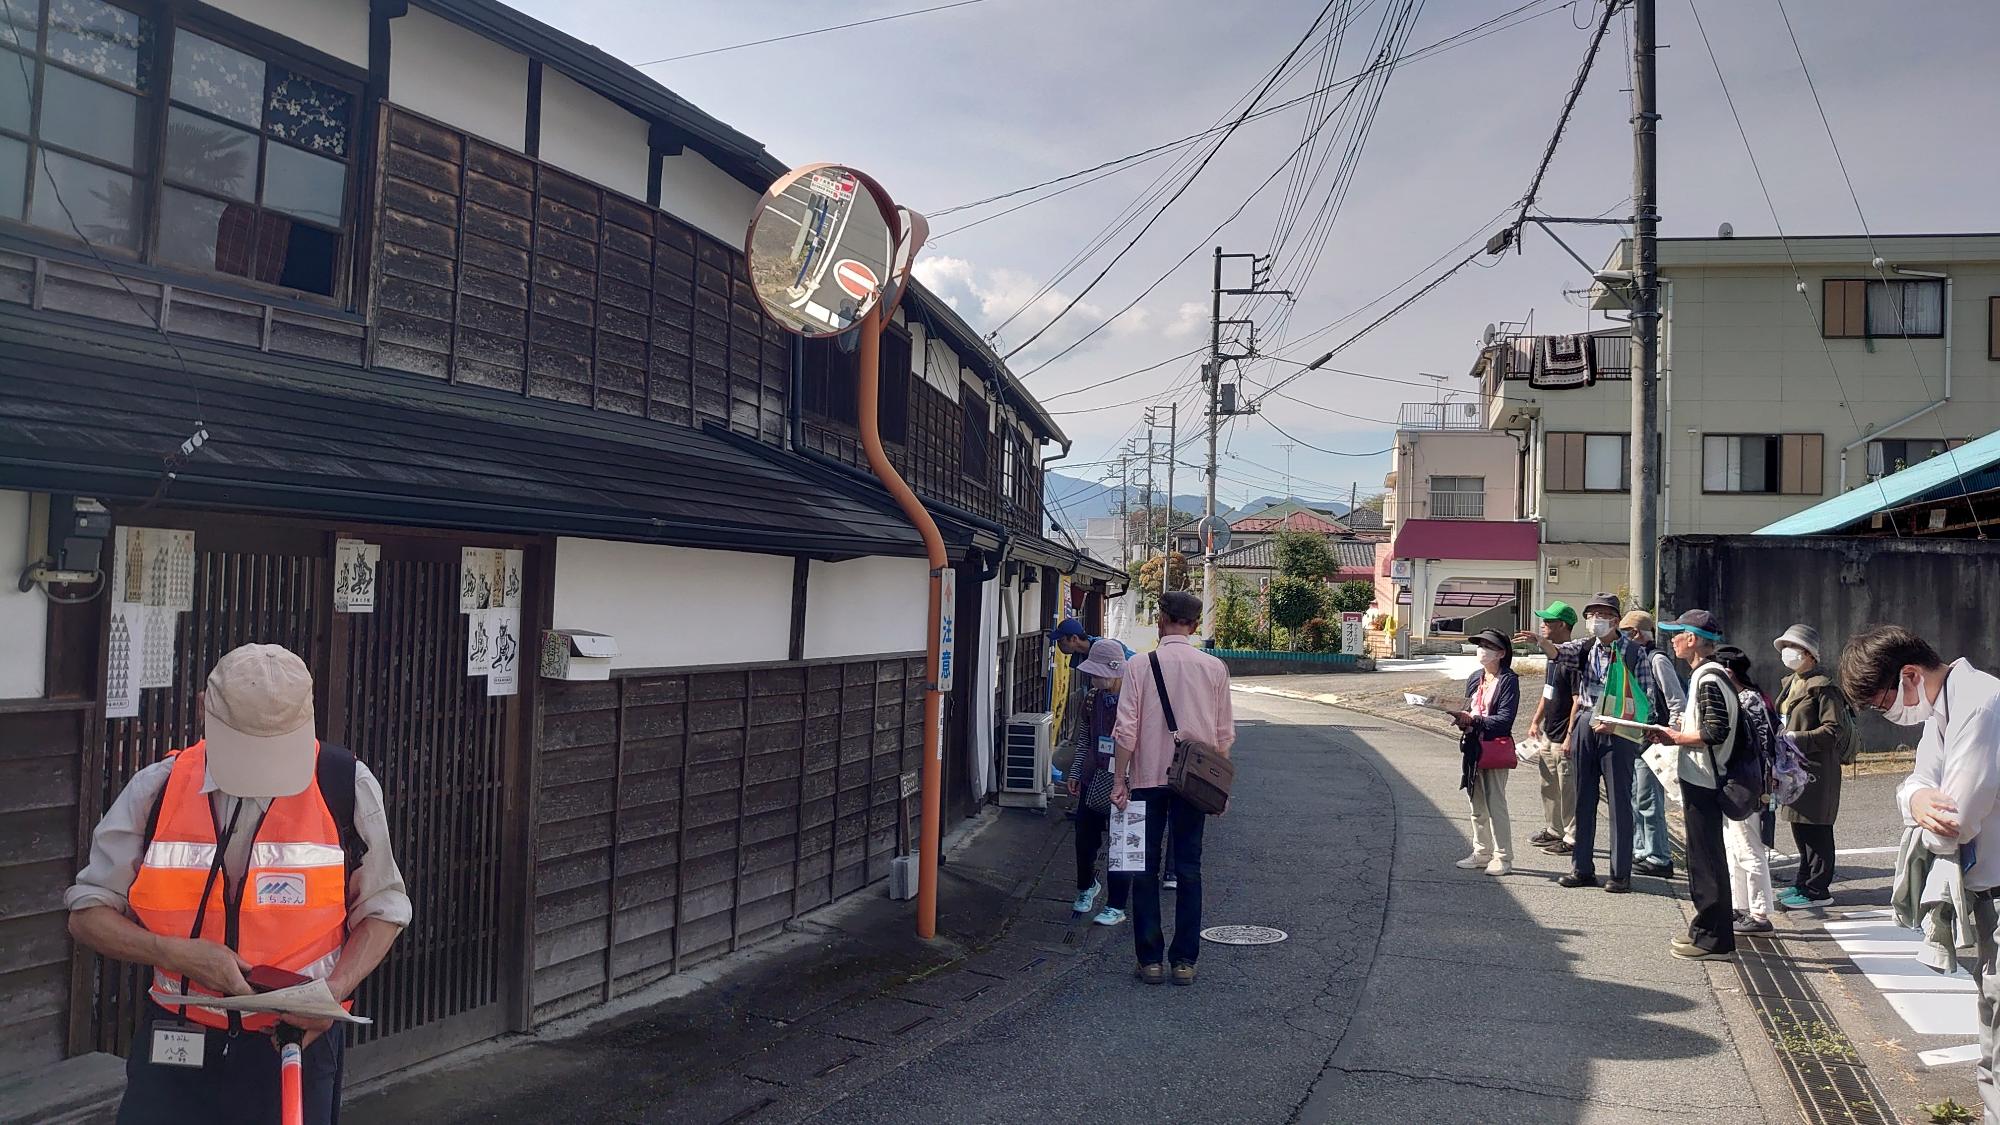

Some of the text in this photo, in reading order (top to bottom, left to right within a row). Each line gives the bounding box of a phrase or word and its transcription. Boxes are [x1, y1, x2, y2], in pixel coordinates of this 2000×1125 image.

[941, 615, 952, 679] 注意
[1346, 622, 1354, 652] オオツカ
